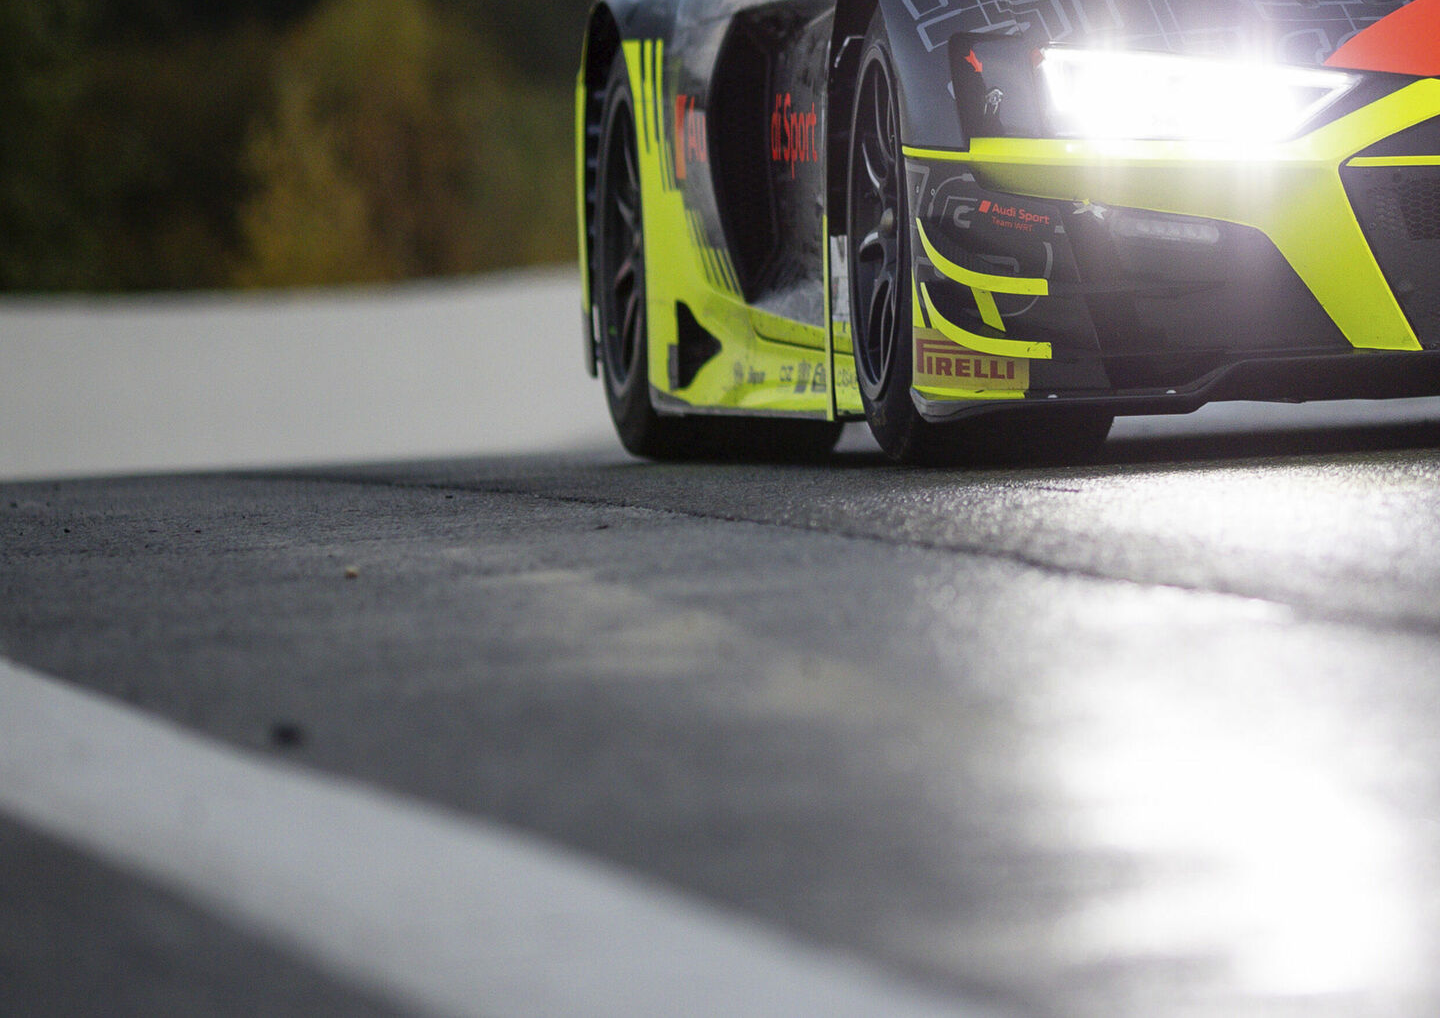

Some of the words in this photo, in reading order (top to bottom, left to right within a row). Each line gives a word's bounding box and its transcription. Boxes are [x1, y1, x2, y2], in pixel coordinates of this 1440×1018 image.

[783, 92, 818, 179] Sport
[992, 203, 1016, 217] Audi
[1018, 208, 1050, 225] Sport
[915, 338, 1016, 380] PIRELLI
